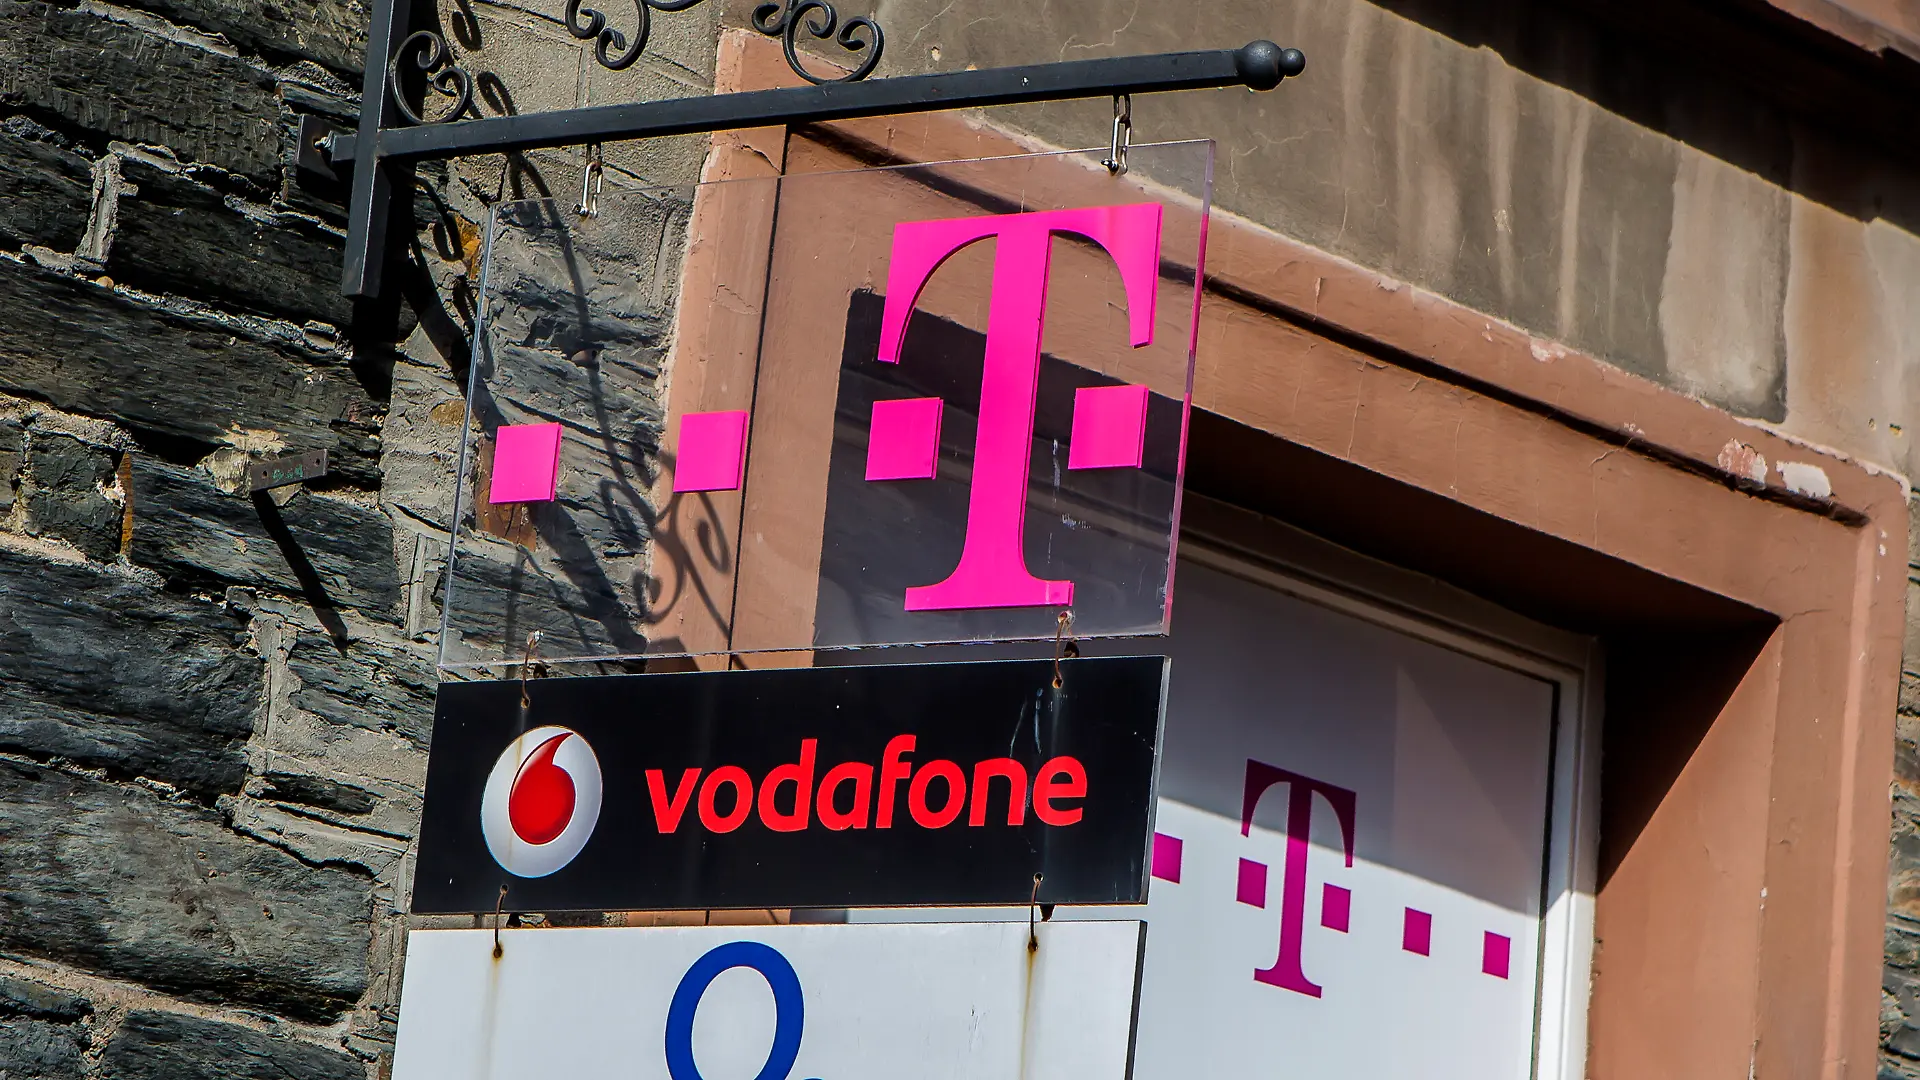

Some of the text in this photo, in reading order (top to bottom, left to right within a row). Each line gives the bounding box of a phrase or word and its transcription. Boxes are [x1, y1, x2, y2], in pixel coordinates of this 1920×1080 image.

[878, 203, 1163, 611] T
[645, 734, 1088, 834] vodafone
[1240, 759, 1357, 999] T
